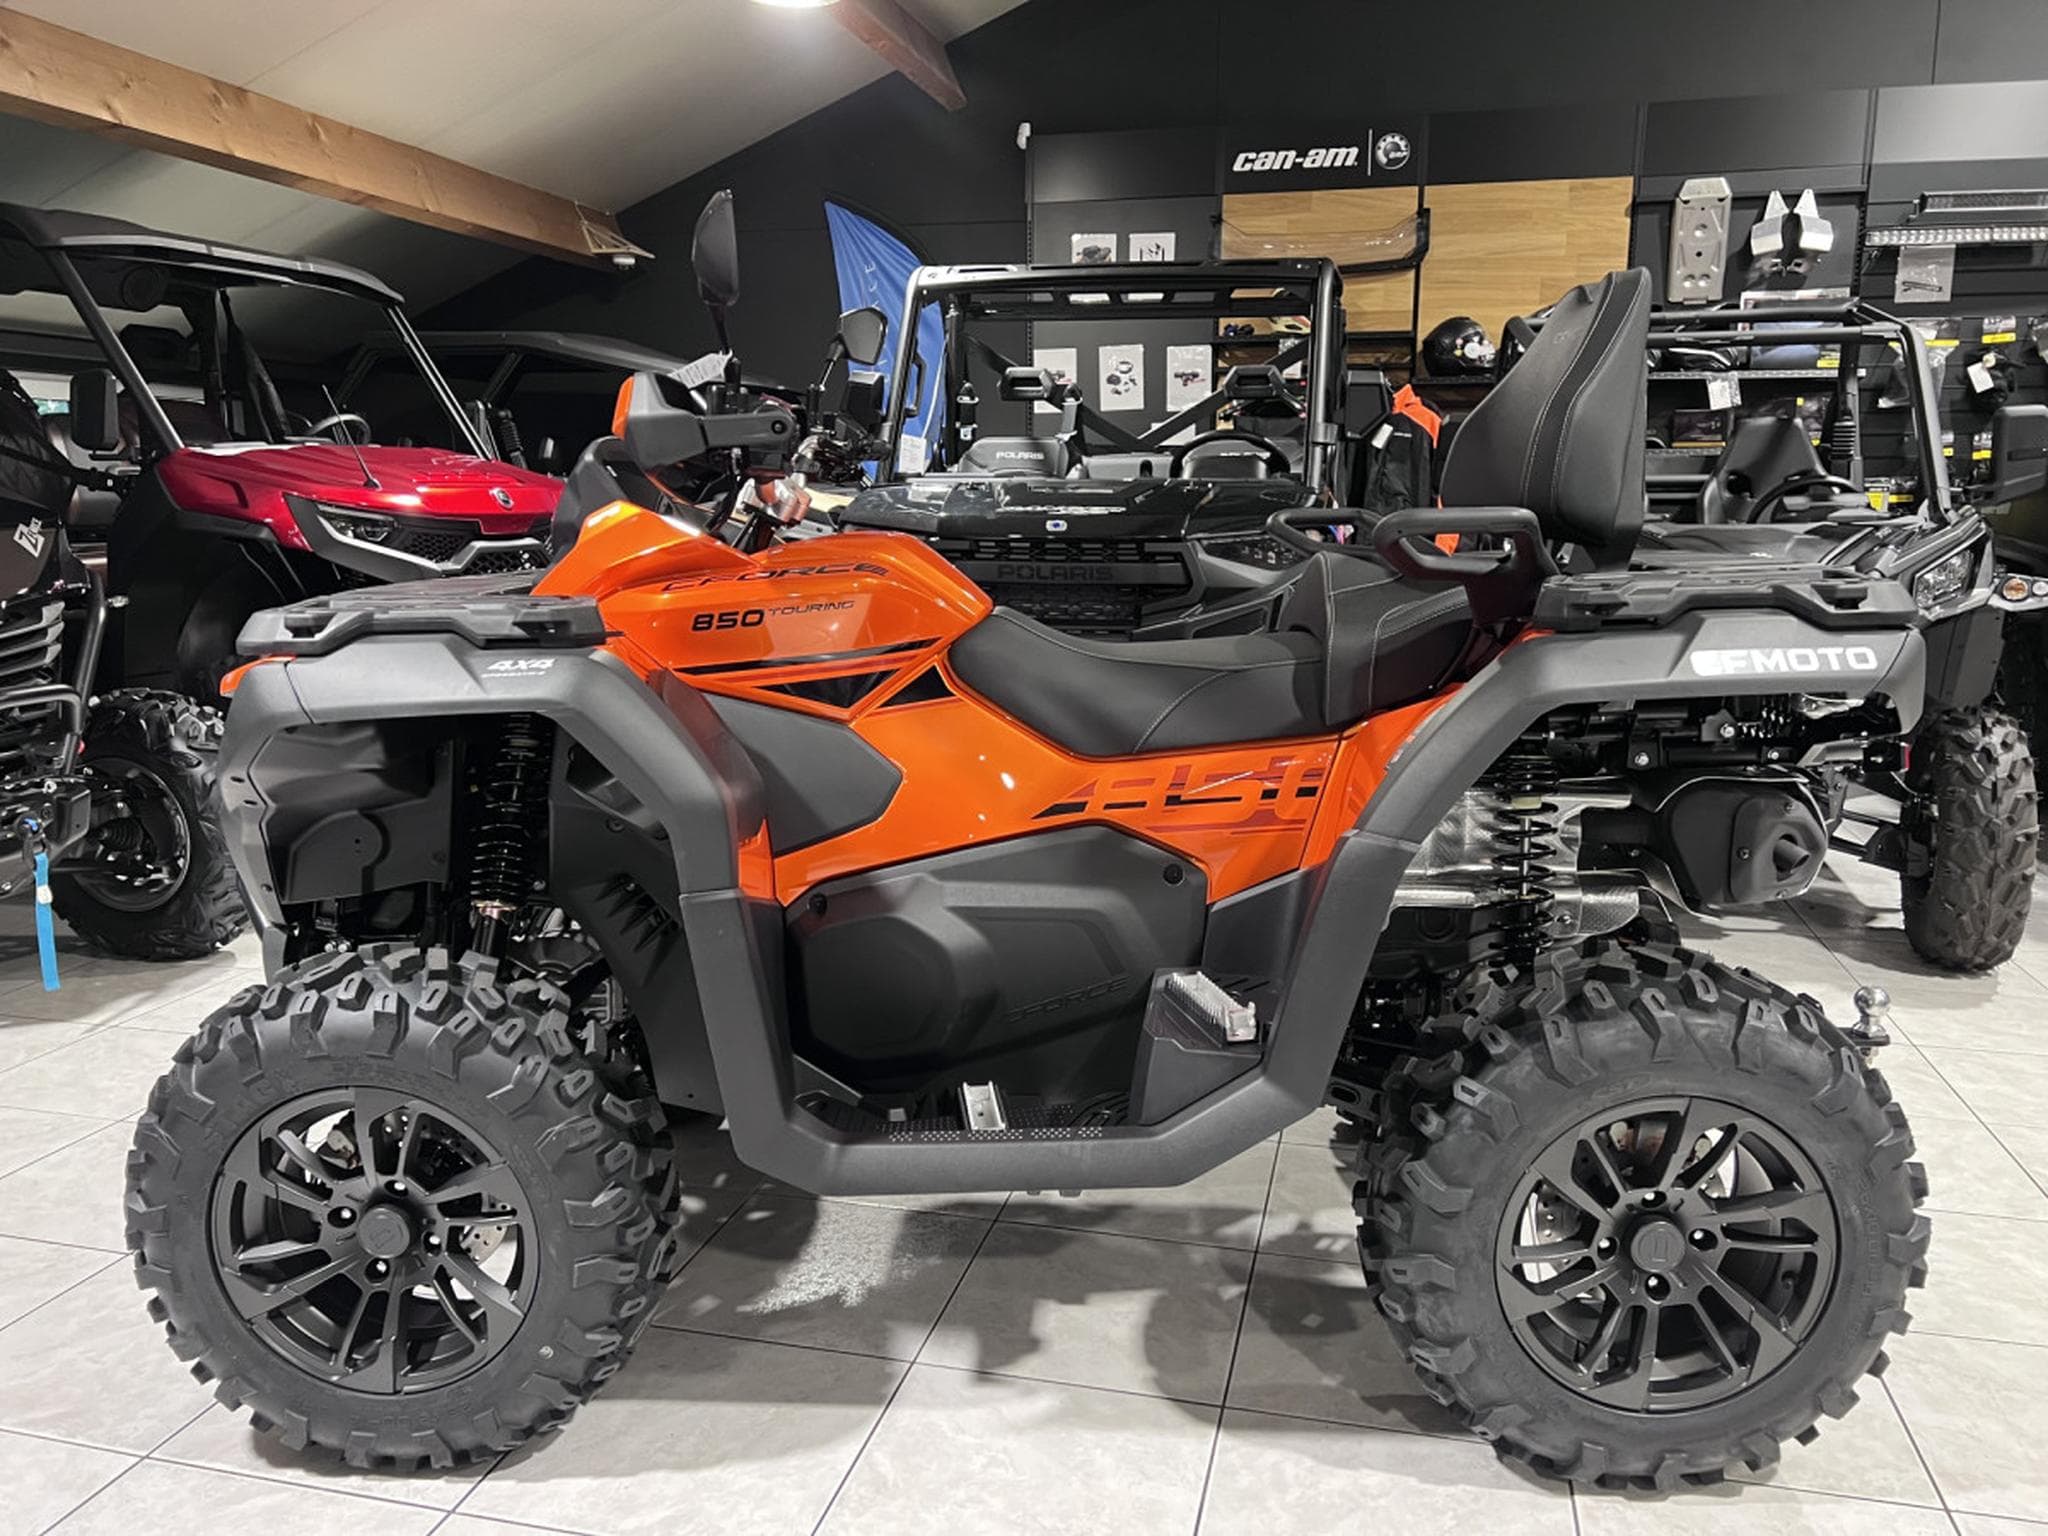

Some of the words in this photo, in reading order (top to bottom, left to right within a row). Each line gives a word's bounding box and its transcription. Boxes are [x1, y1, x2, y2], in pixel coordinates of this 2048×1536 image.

[1232, 146, 1360, 172] can-am
[996, 451, 1045, 460] POLARIS
[998, 563, 1114, 581] POLARIS
[690, 608, 765, 632] 850
[769, 600, 856, 616] TOURING
